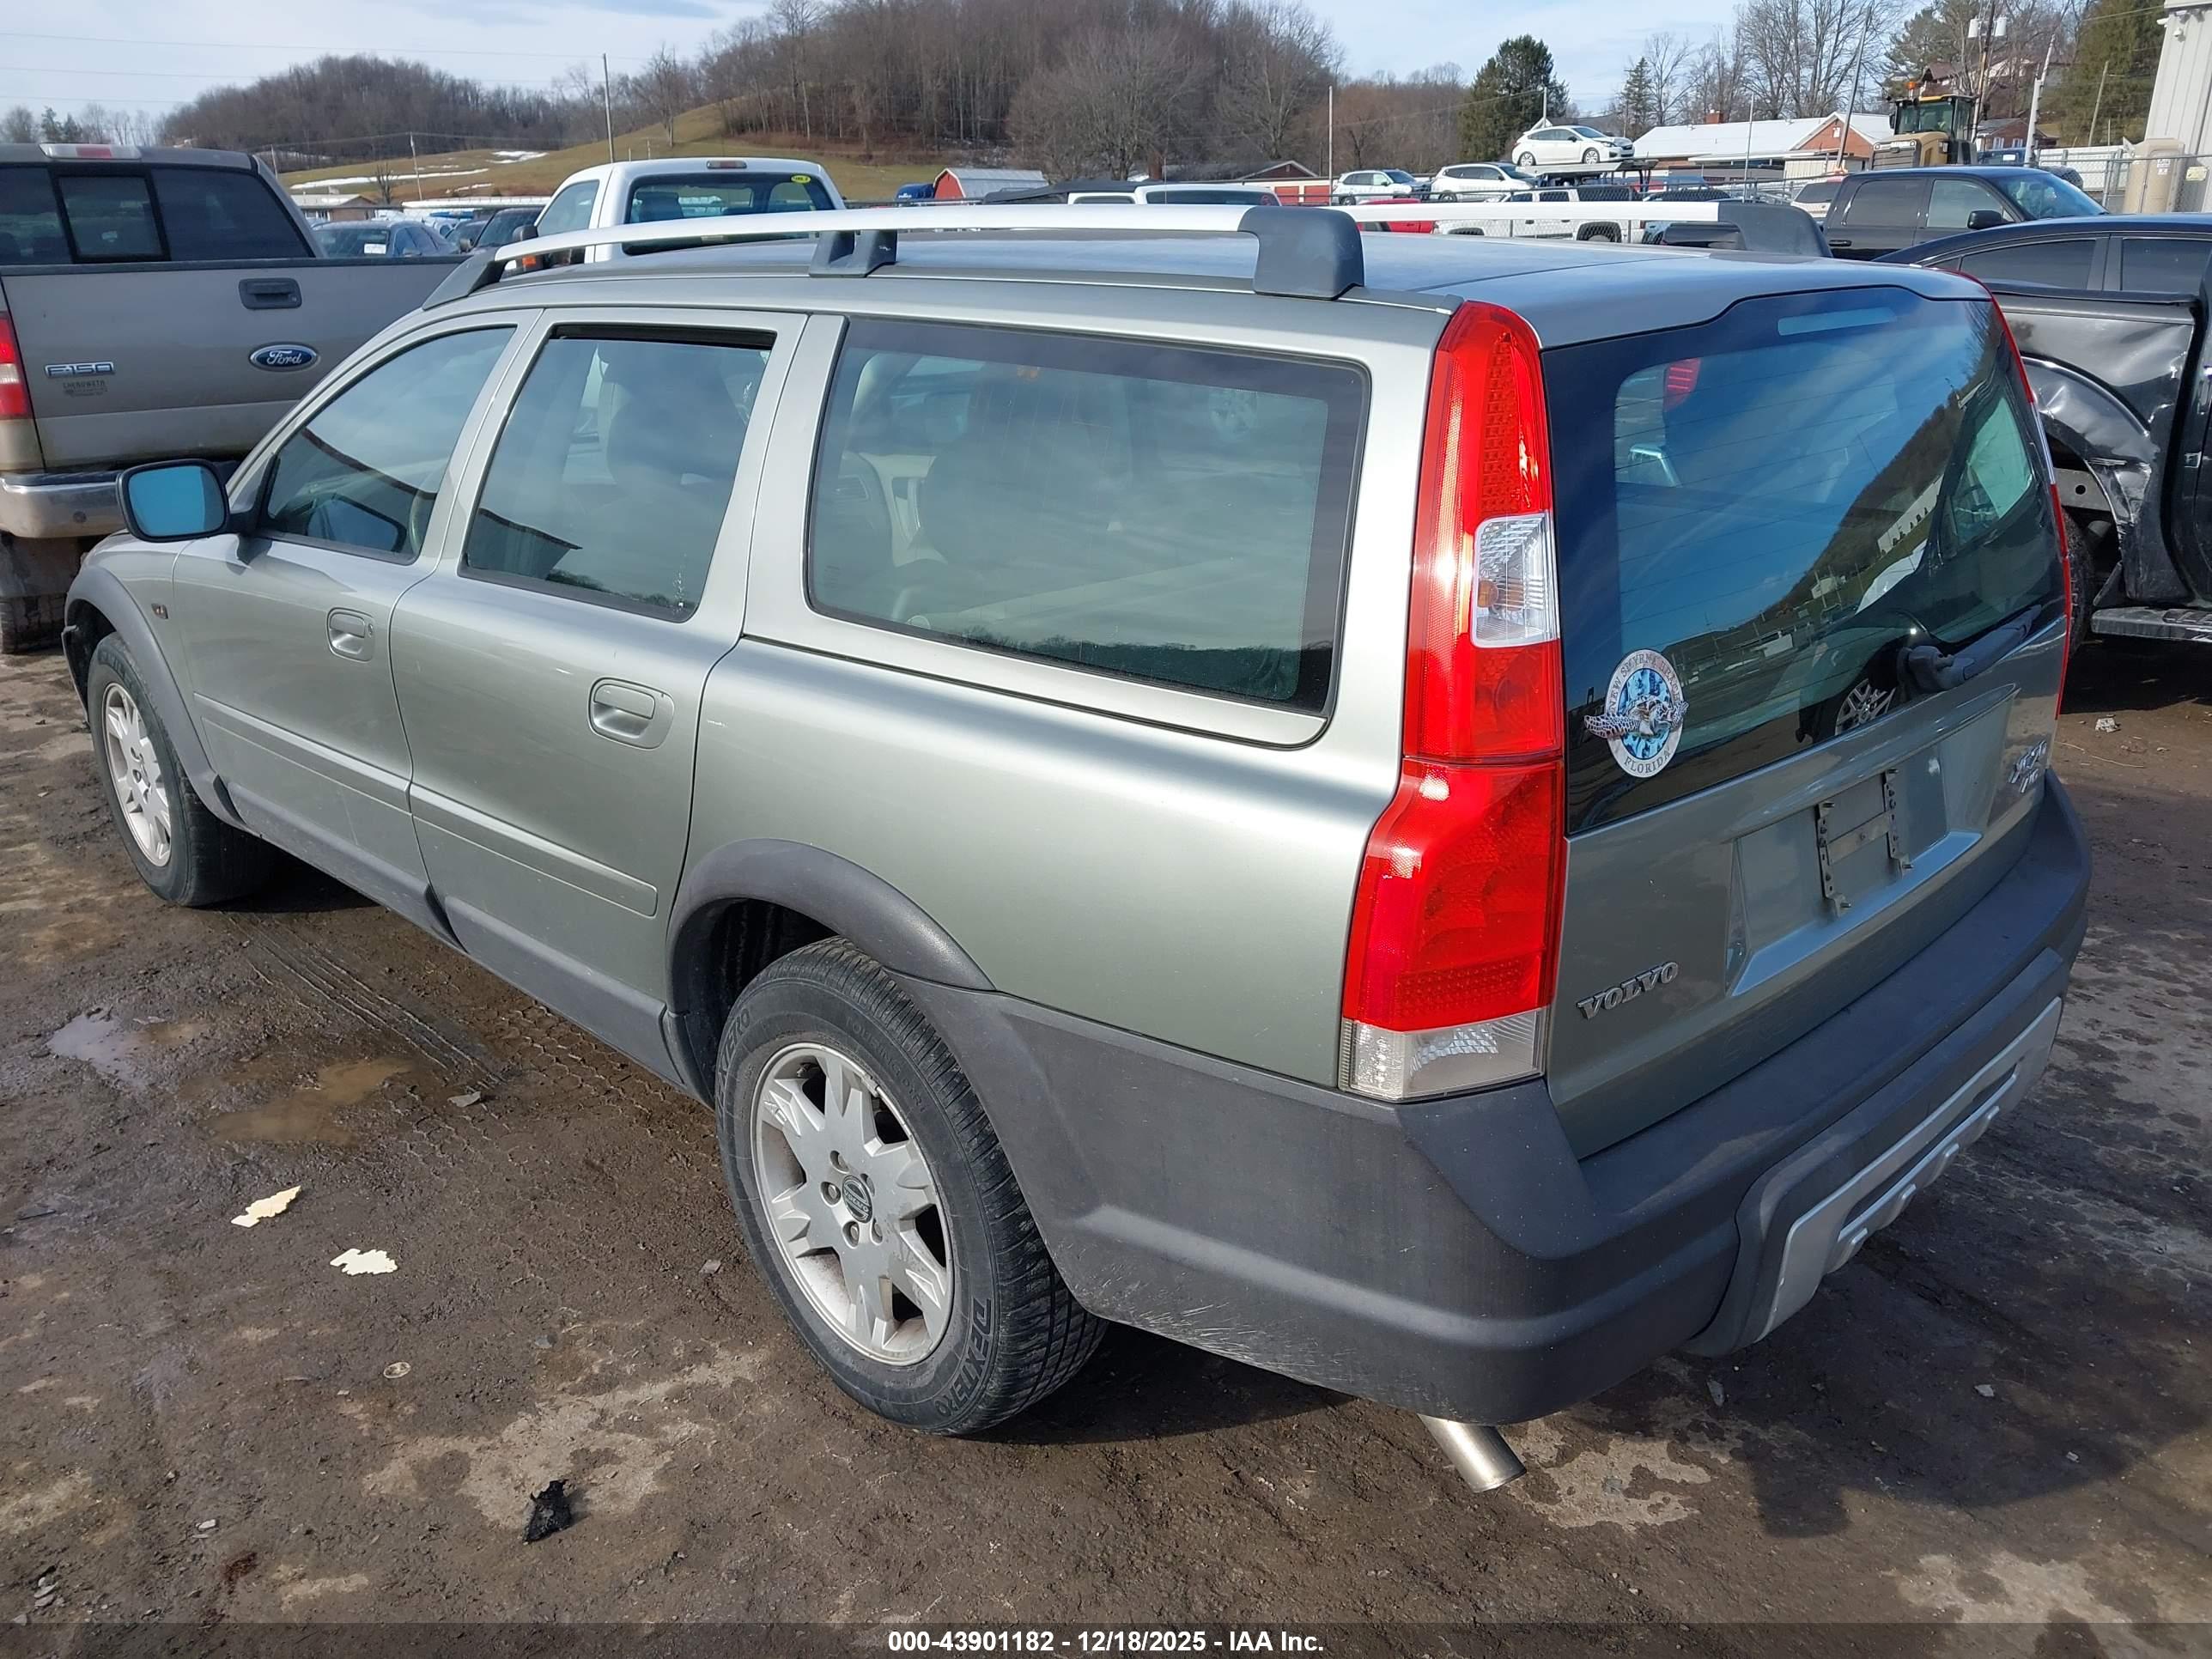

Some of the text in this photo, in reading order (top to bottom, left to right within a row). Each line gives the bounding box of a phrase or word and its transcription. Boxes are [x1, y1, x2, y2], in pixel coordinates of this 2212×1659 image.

[266, 349, 303, 365] Ford
[1608, 677, 1622, 714] NEW
[1623, 746, 1671, 775] FLORIDA
[1577, 961, 1680, 1020] VOLVO
[843, 1188, 870, 1212] VOLVO
